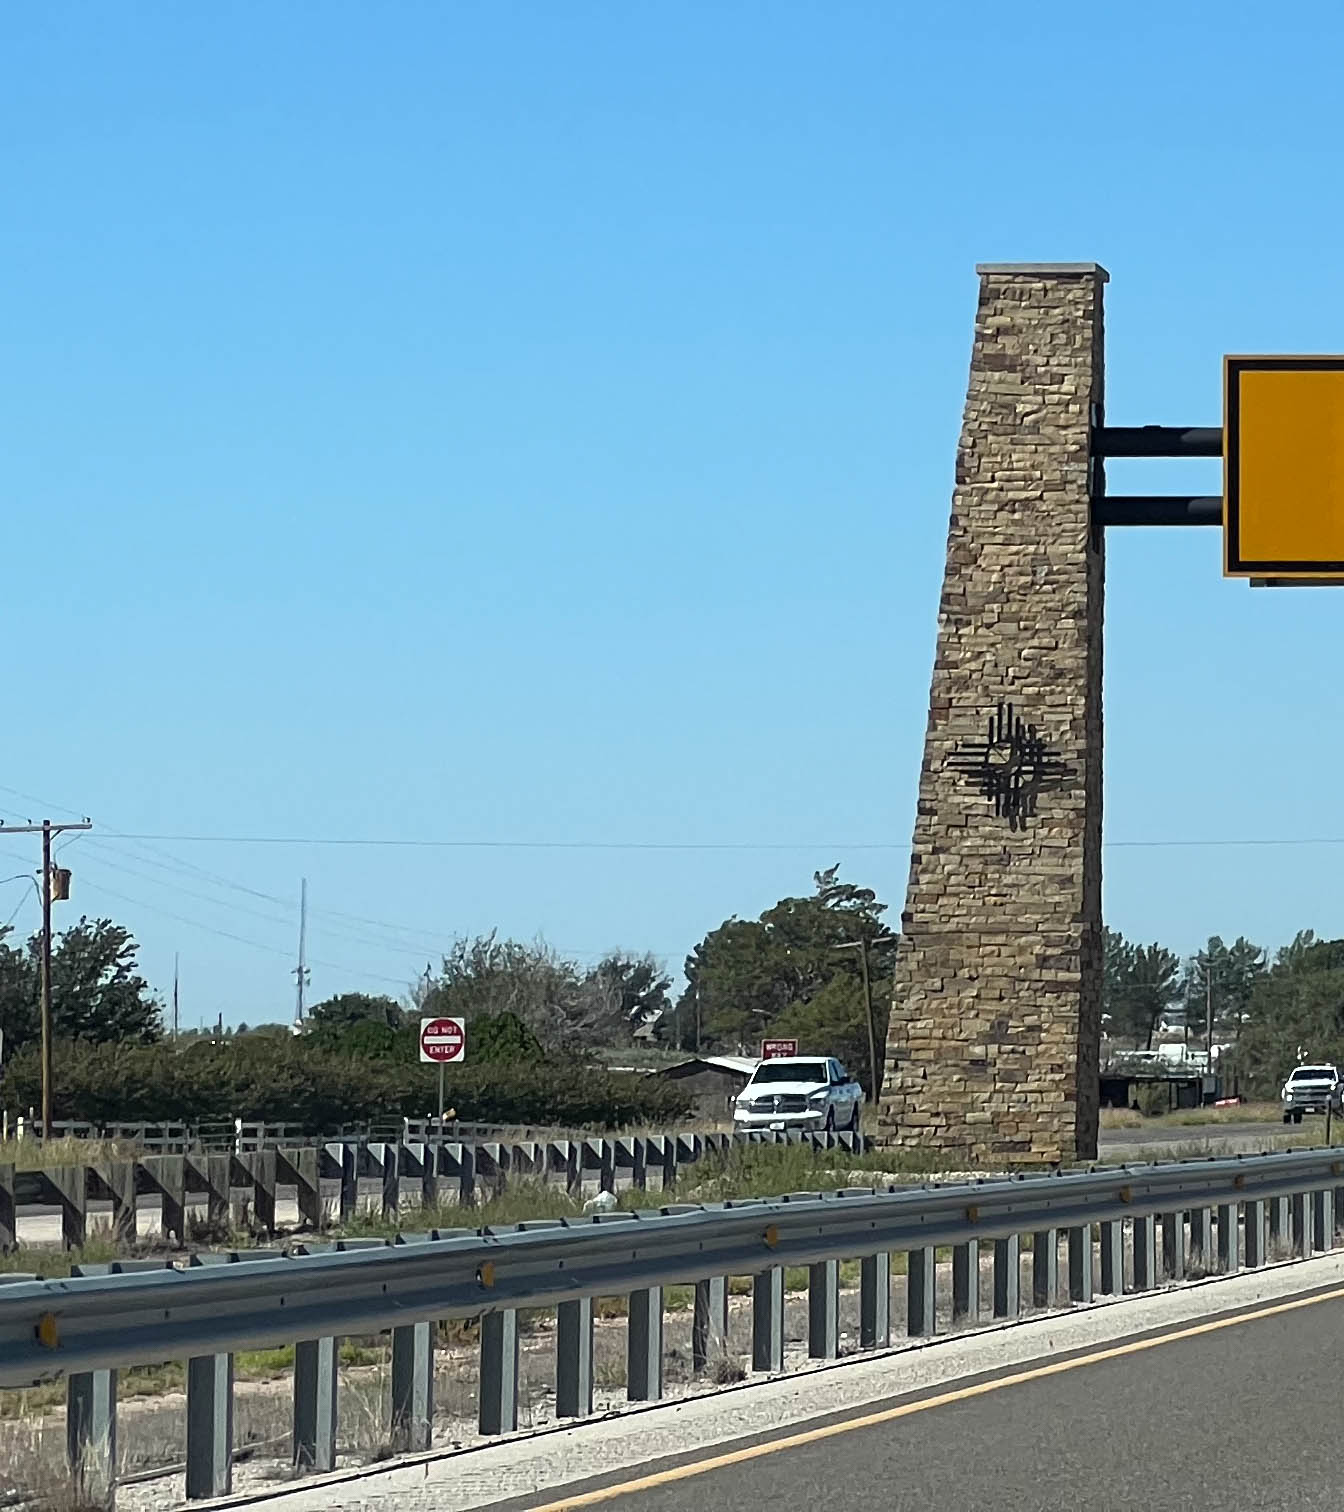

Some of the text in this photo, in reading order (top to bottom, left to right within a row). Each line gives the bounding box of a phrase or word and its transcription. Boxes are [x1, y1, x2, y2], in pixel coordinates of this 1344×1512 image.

[427, 1025, 457, 1034] DO NOT
[429, 1045, 455, 1054] ENTER
